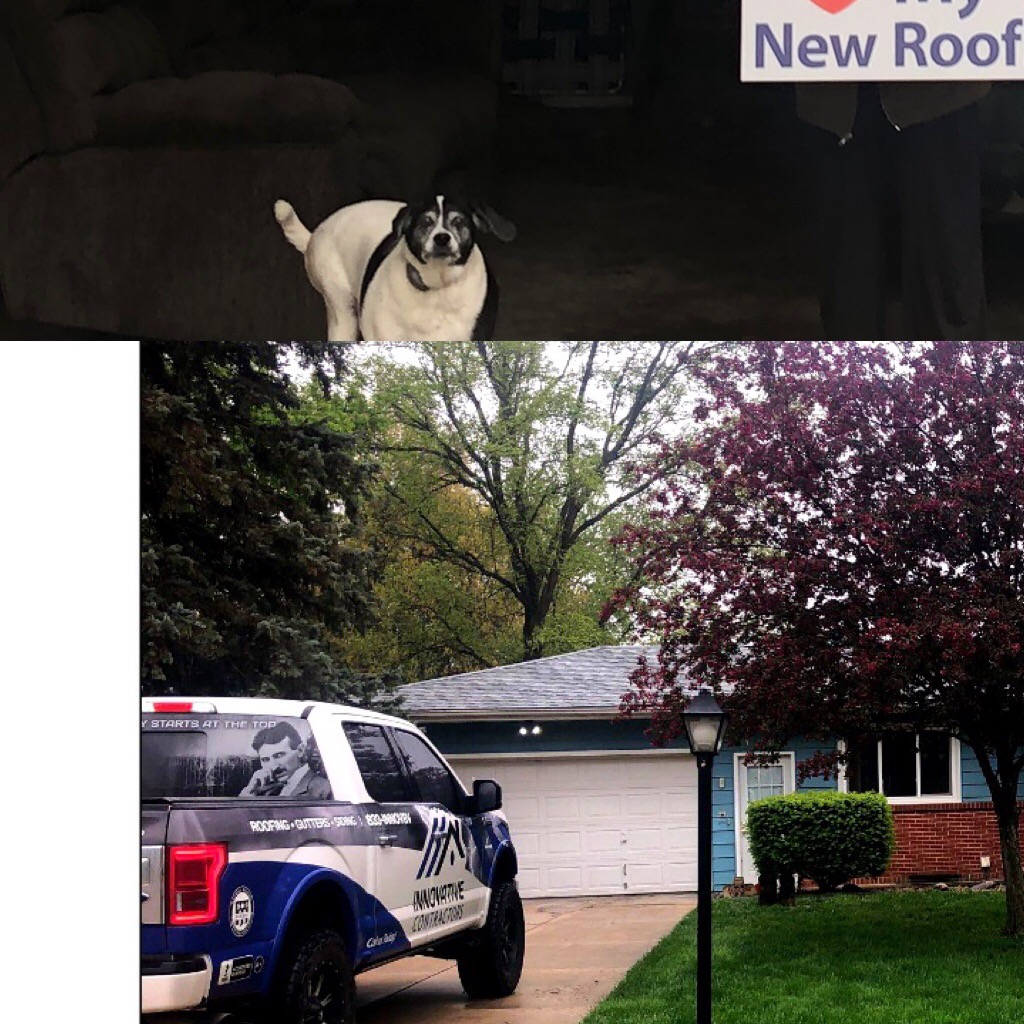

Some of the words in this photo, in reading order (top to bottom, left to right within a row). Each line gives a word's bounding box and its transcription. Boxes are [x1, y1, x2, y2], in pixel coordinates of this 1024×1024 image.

[755, 23, 877, 68] New
[151, 719, 199, 728] STARTS
[202, 720, 220, 728] AT
[225, 720, 248, 728] THE
[252, 720, 276, 729] TOP
[249, 819, 290, 832] ROOFING
[294, 817, 331, 830] GUTTERS
[413, 880, 465, 911] INNOVATIVE
[412, 904, 465, 933] CONTRACTORS
